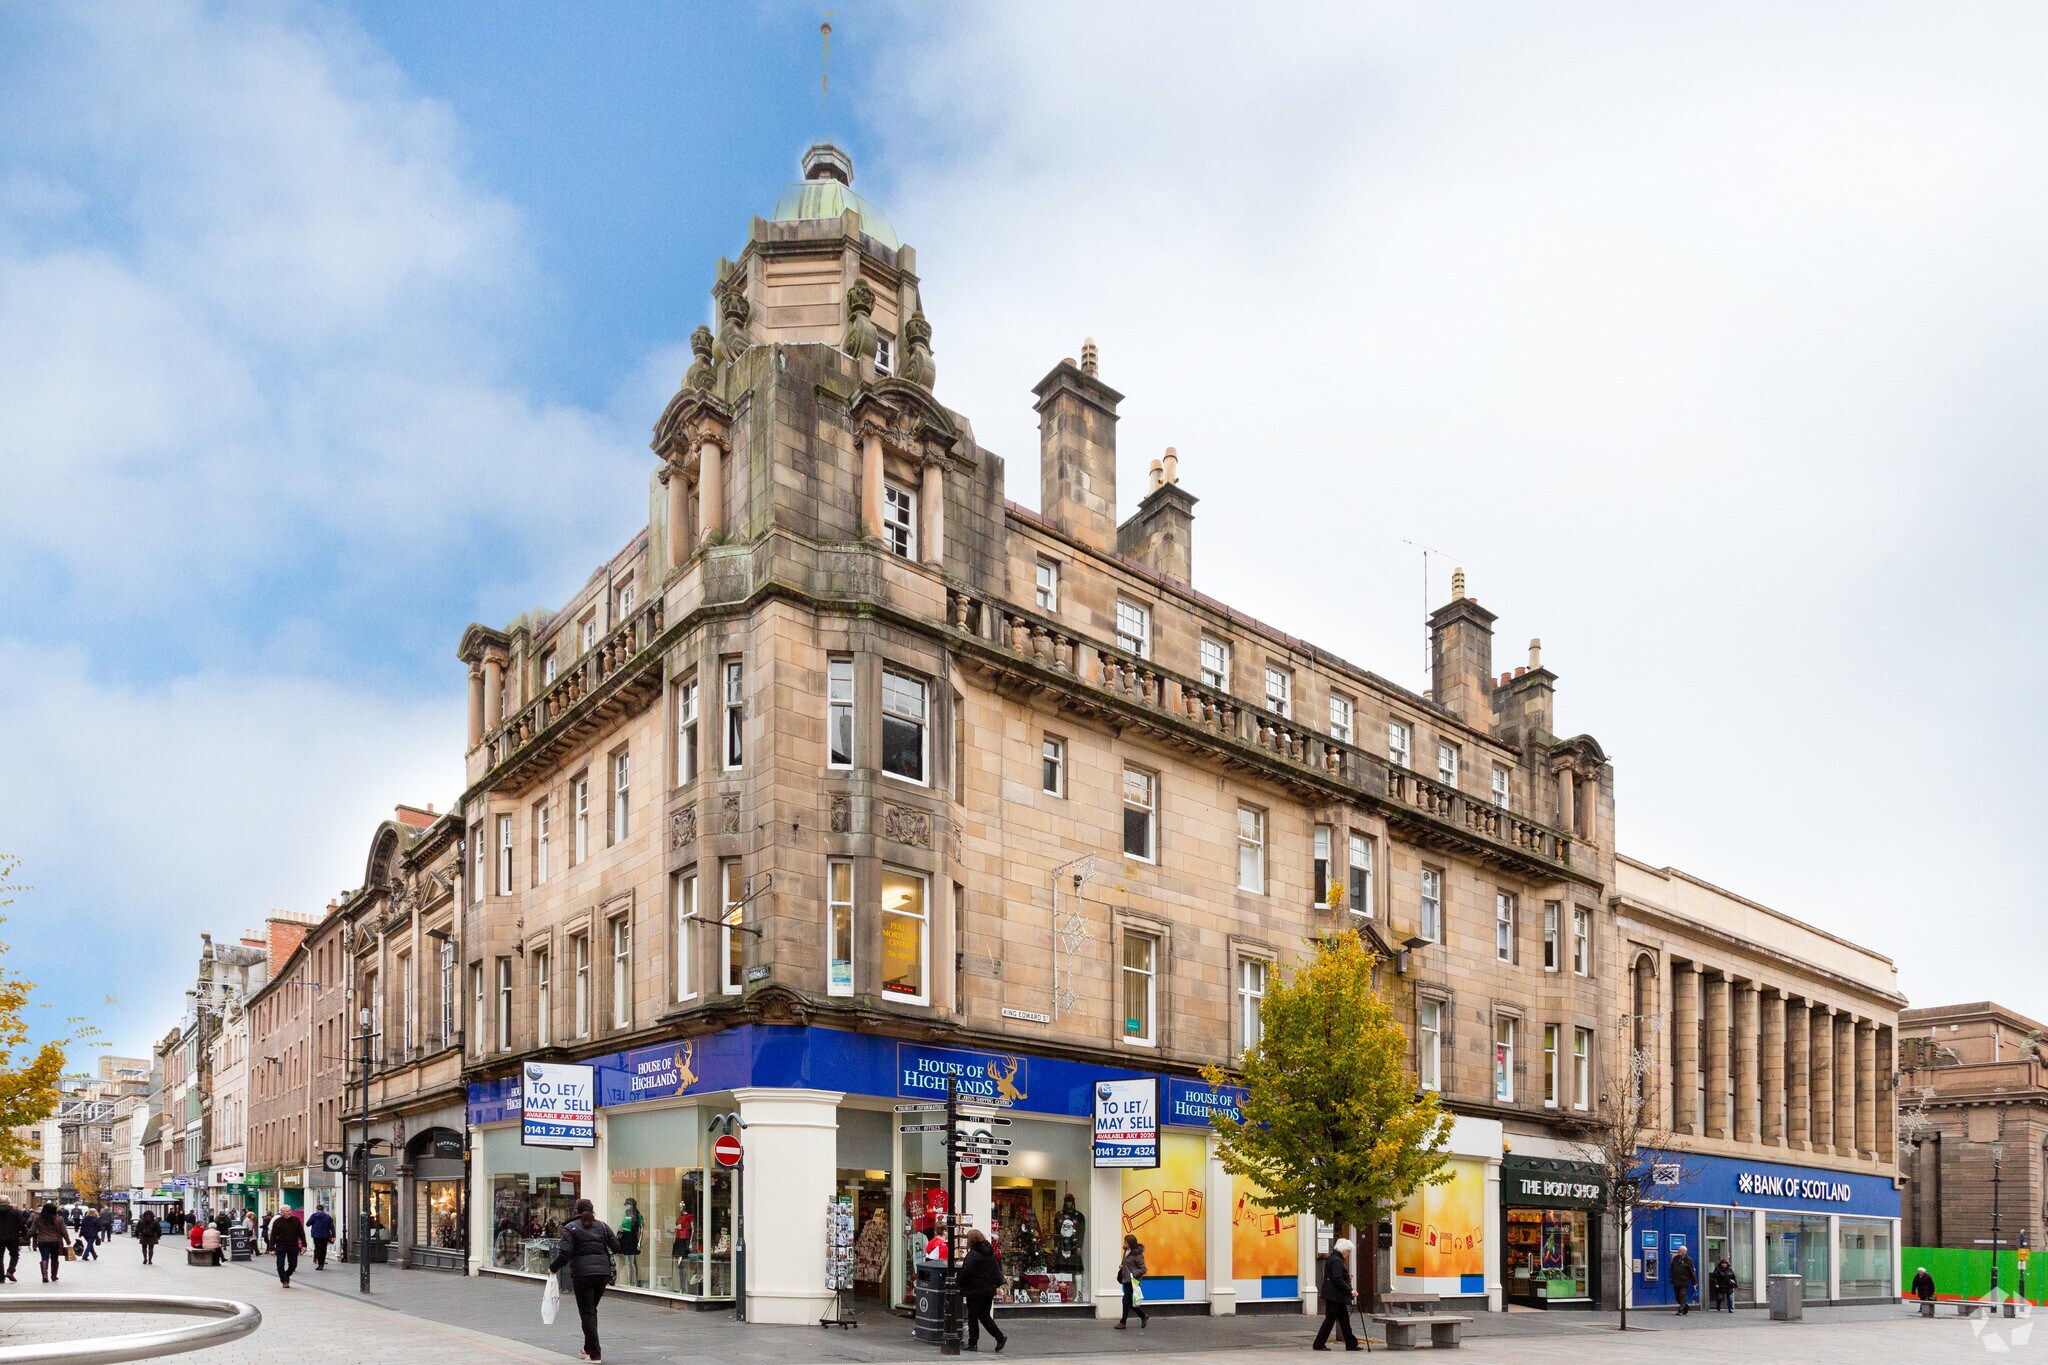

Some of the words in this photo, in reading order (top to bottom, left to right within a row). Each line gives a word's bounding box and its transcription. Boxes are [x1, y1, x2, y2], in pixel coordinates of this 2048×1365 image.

[1003, 1009, 1017, 1017] KING
[1018, 1011, 1041, 1020] EDWARD
[638, 1060, 662, 1075] HOUSE
[662, 1057, 672, 1070] OF
[918, 1059, 964, 1077] HOUSE
[966, 1065, 984, 1079] OF
[631, 1070, 677, 1091] HIGHLANDS
[903, 1070, 993, 1095] HIGHANDS
[532, 1082, 550, 1095] TO
[557, 1084, 584, 1097] LET/
[526, 1097, 557, 1110] MAY
[564, 1099, 591, 1111] SELL
[1185, 1091, 1218, 1105] HOUSE
[1219, 1095, 1233, 1106] OF
[1103, 1102, 1118, 1114] TO
[1124, 1099, 1148, 1114] LET/
[1097, 1118, 1123, 1130] MAY
[1130, 1116, 1154, 1130] SELL
[525, 1126, 546, 1134] 0141
[549, 1127, 566, 1135] 237
[570, 1128, 592, 1136] 4324
[1096, 1147, 1114, 1157] 0141
[1117, 1147, 1131, 1156] 237
[1134, 1146, 1155, 1156] 4324
[1520, 1179, 1542, 1195] THE
[1543, 1181, 1573, 1197] BODY
[1573, 1183, 1600, 1199] SHOP
[1754, 1174, 1784, 1197] BANK
[1785, 1177, 1800, 1197] OF
[1802, 1179, 1851, 1201] SCOTLAND
